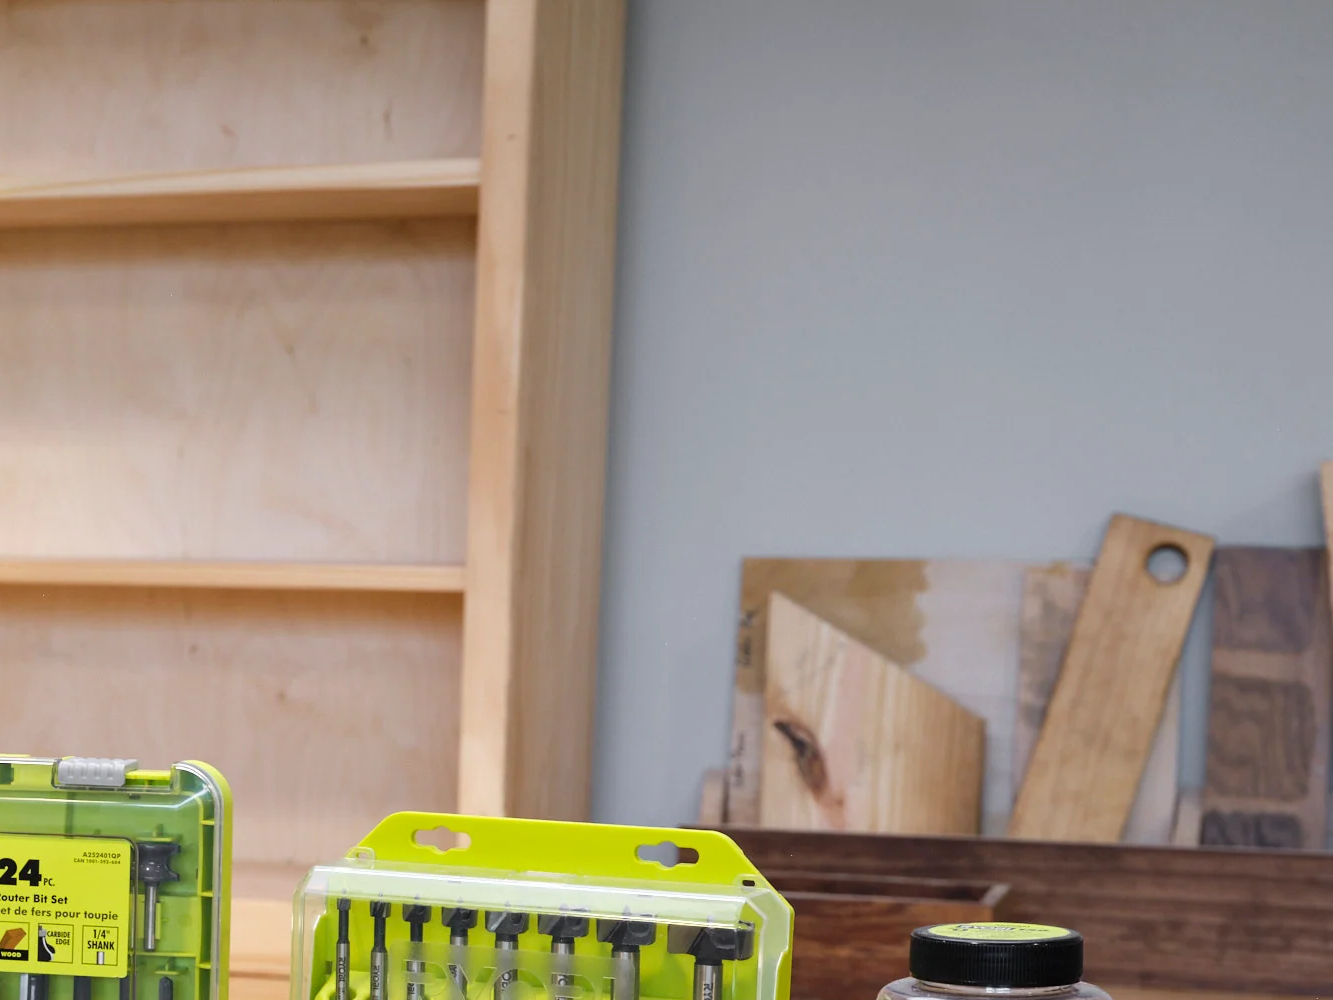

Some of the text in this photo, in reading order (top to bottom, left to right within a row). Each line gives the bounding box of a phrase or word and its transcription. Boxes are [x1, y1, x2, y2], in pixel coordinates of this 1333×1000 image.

[44, 878, 55, 886] PC.
[34, 895, 48, 903] Bit
[51, 895, 68, 904] Set
[14, 907, 27, 915] de
[32, 908, 51, 917] fers
[55, 911, 80, 919] pour
[84, 911, 118, 921] toupie
[93, 929, 110, 939] 1/4"
[88, 941, 114, 950] SHANK
